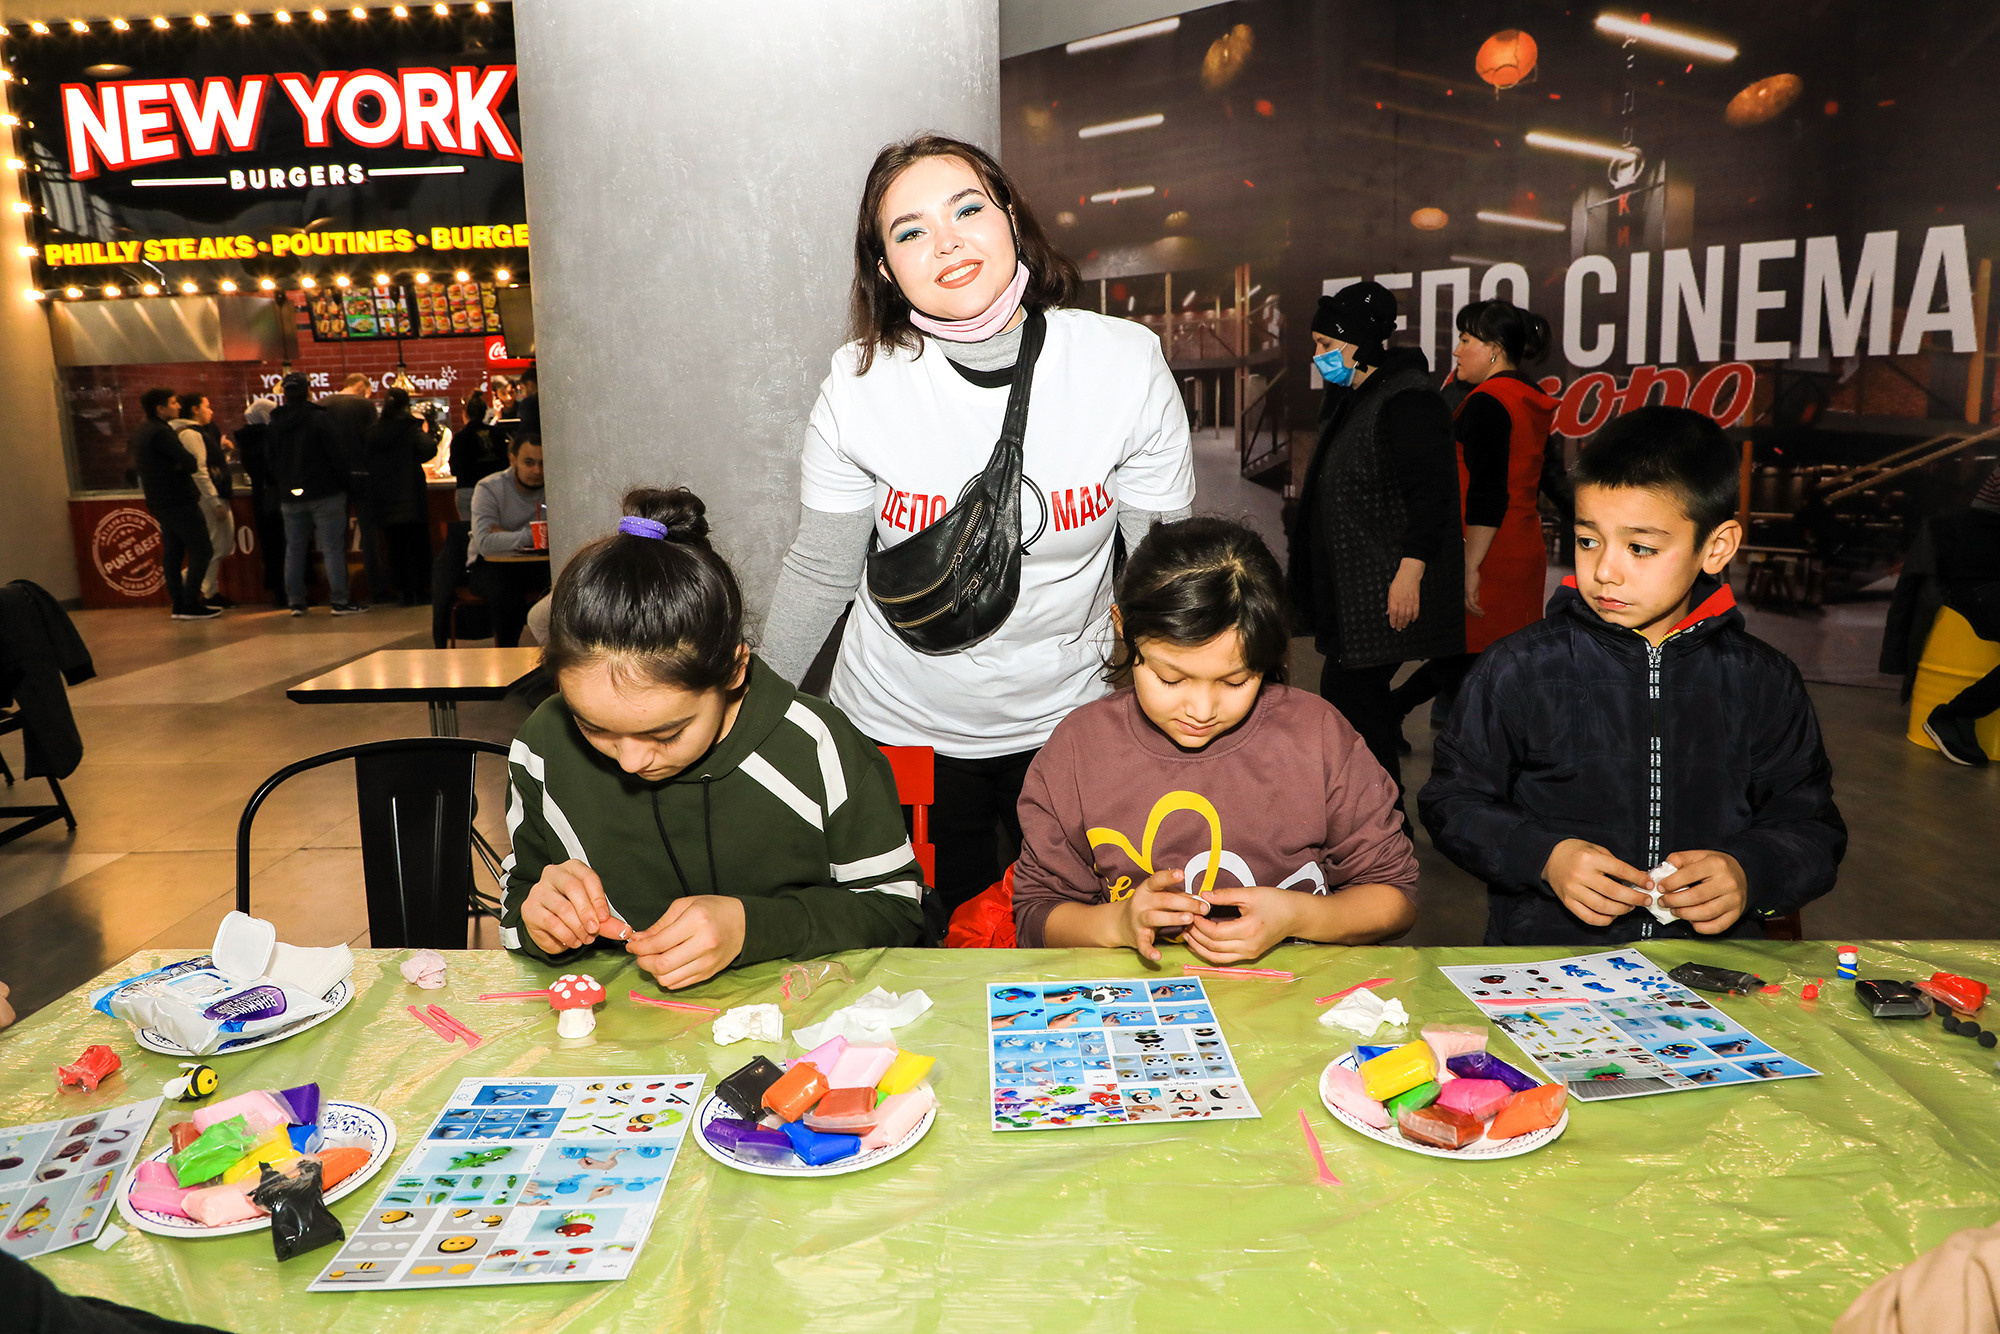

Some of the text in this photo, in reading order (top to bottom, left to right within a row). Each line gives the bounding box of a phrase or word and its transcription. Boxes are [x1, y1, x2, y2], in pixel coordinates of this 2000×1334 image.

[60, 64, 523, 181] NEW YORK
[229, 163, 364, 190] BURGERS
[45, 240, 142, 267] PHILLY
[143, 234, 257, 262] STEAKS
[271, 228, 416, 257] POUTINES
[1562, 224, 1978, 369] CINEMA
[880, 482, 1115, 533] ДЕПО MALL
[103, 548, 136, 575] PURE
[133, 531, 161, 557] BEEF
